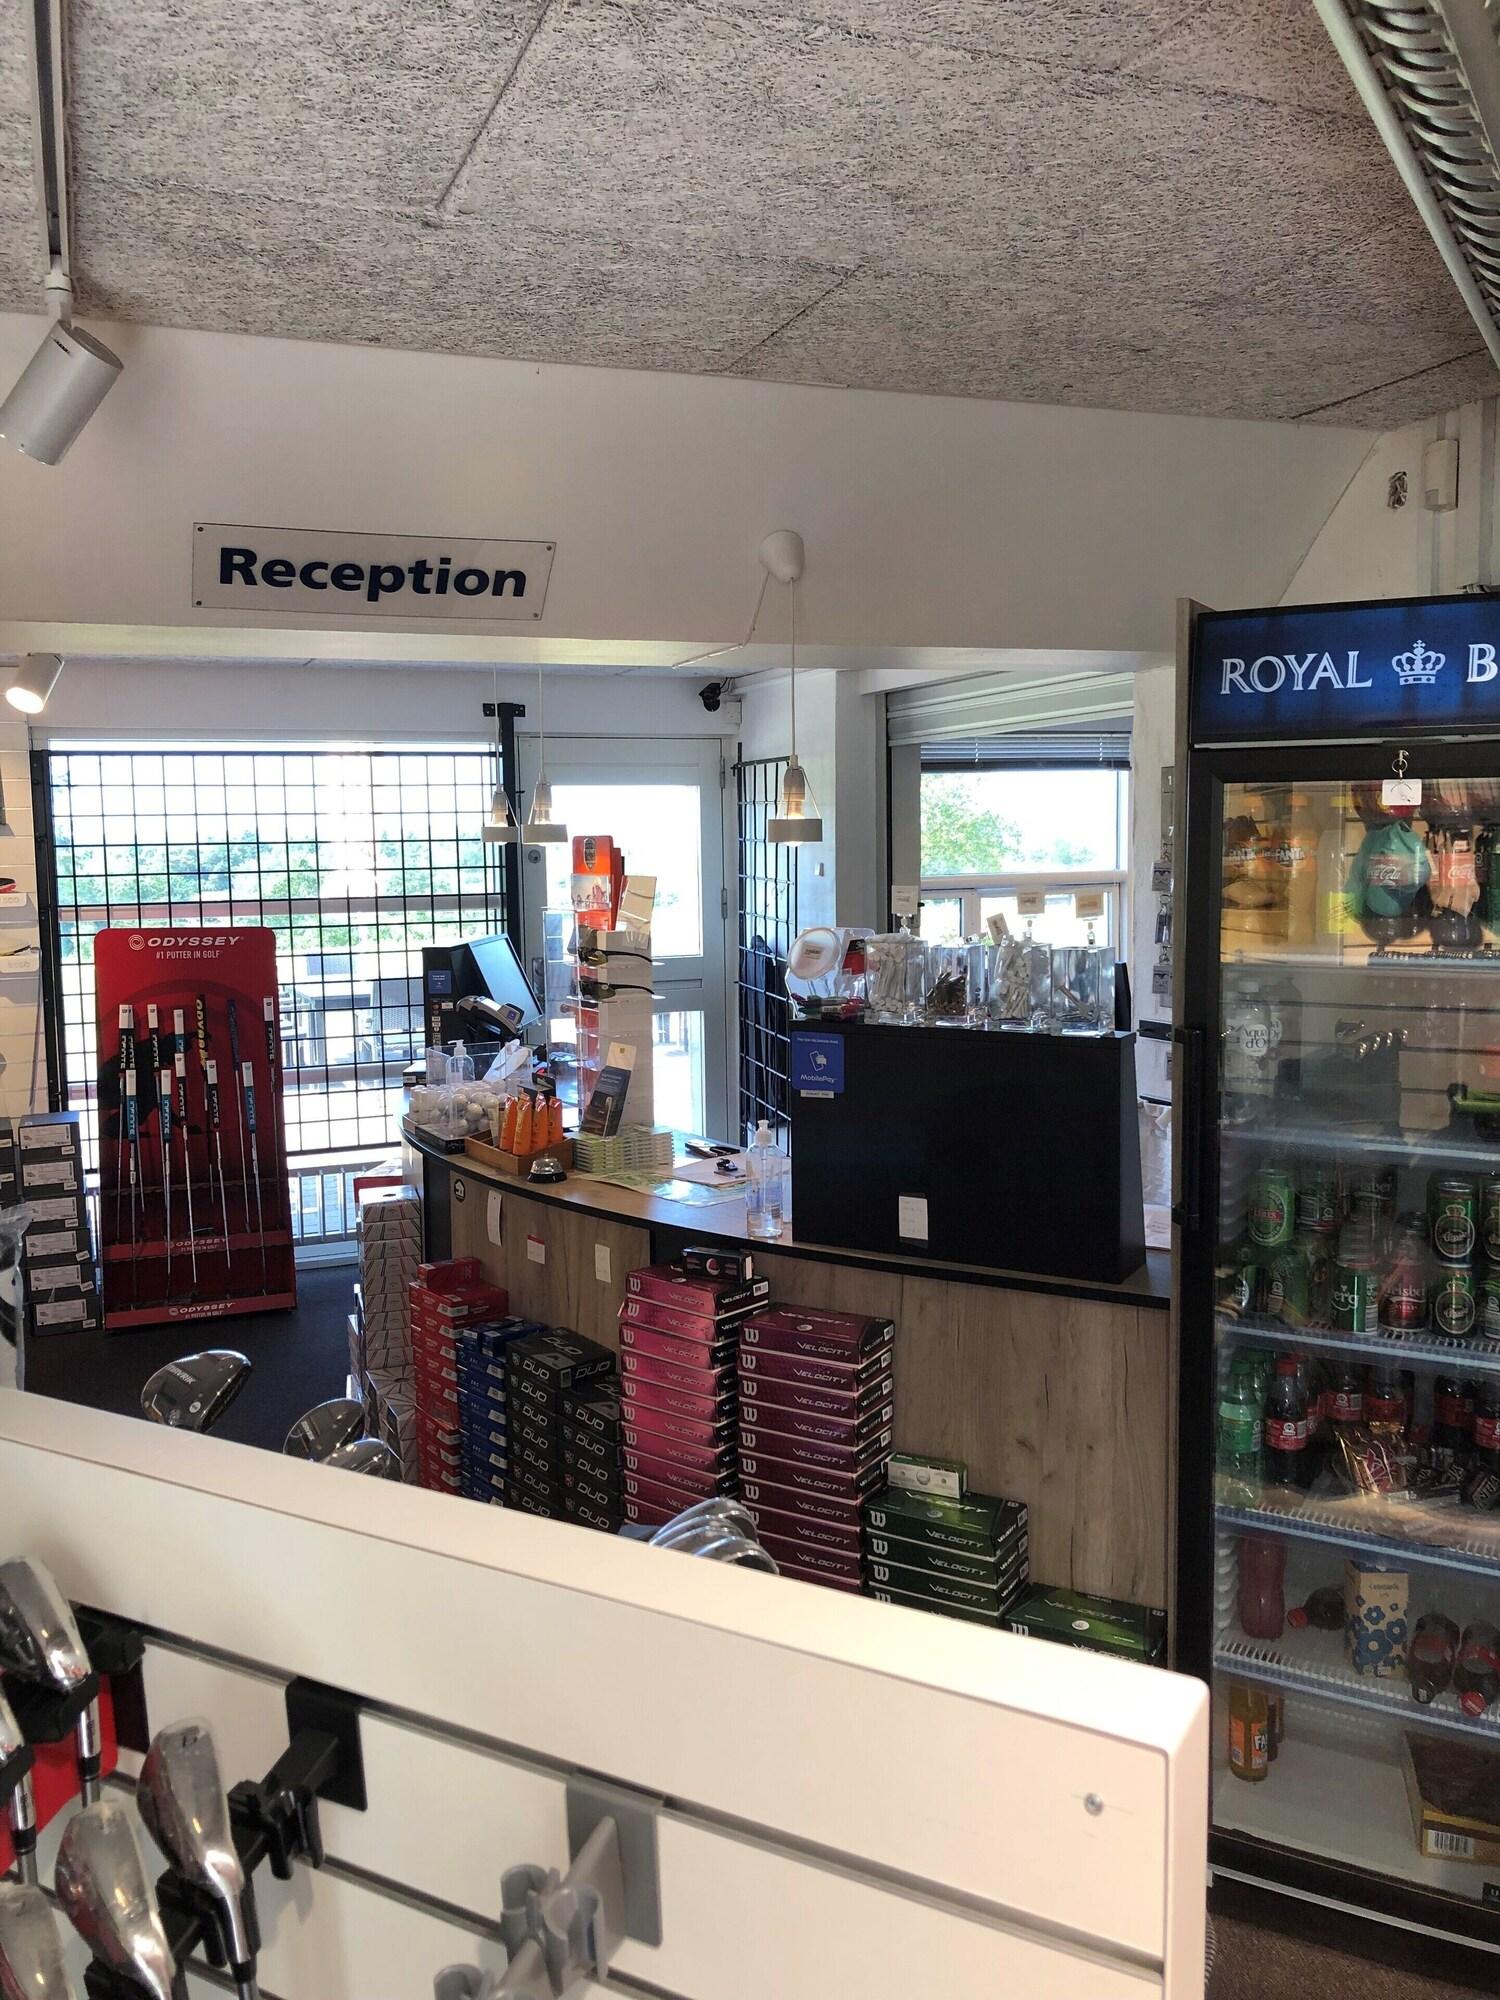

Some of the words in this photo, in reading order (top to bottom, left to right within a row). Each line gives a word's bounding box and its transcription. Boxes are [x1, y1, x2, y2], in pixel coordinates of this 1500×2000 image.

[219, 547, 527, 602] Reception
[1220, 650, 1373, 695] ROYAL
[147, 936, 240, 947] ODYSSEY
[156, 951, 164, 960] #1
[166, 951, 192, 960] PUTTER
[194, 951, 201, 959] IN
[203, 951, 221, 959] GOLF
[800, 1074, 835, 1084] MobilePay
[179, 1302, 233, 1314] ODYSSEY
[744, 1328, 760, 1344] W
[796, 1341, 852, 1357] VELOCITY
[523, 1360, 550, 1380] DUO
[575, 1360, 611, 1379] DUO
[742, 1354, 757, 1369] W
[793, 1368, 848, 1384] VELOCITY
[521, 1382, 548, 1402] DUO
[742, 1380, 758, 1396] W
[794, 1394, 848, 1411] VELOCITY
[522, 1405, 548, 1426] DUO
[576, 1408, 605, 1431] DUO
[742, 1406, 758, 1422] W
[523, 1428, 548, 1449] DUO
[794, 1421, 849, 1439] VELOCITY
[576, 1434, 605, 1456] DUO
[742, 1432, 757, 1448] W
[523, 1450, 549, 1472] DUO
[666, 1448, 711, 1465] VELOCITY
[742, 1457, 757, 1474] W
[792, 1448, 847, 1465] VELOCITY
[577, 1459, 608, 1480] DUO
[524, 1473, 550, 1495] DUO
[666, 1473, 711, 1492] VELOCITY
[745, 1483, 760, 1500] W
[793, 1473, 848, 1492] VELOCITY
[577, 1482, 608, 1505] DUO
[522, 1496, 550, 1517] DUO
[796, 1500, 850, 1519] VELOCITY
[578, 1506, 610, 1529] DUO
[870, 1510, 886, 1527] W
[796, 1526, 850, 1545] VELOCITY
[925, 1528, 985, 1548] VELOCITY
[872, 1538, 888, 1555] W
[796, 1552, 851, 1571] VELOCITY
[928, 1556, 987, 1576] VELOCITY
[873, 1565, 889, 1581] W
[928, 1583, 988, 1602] VELOCITY
